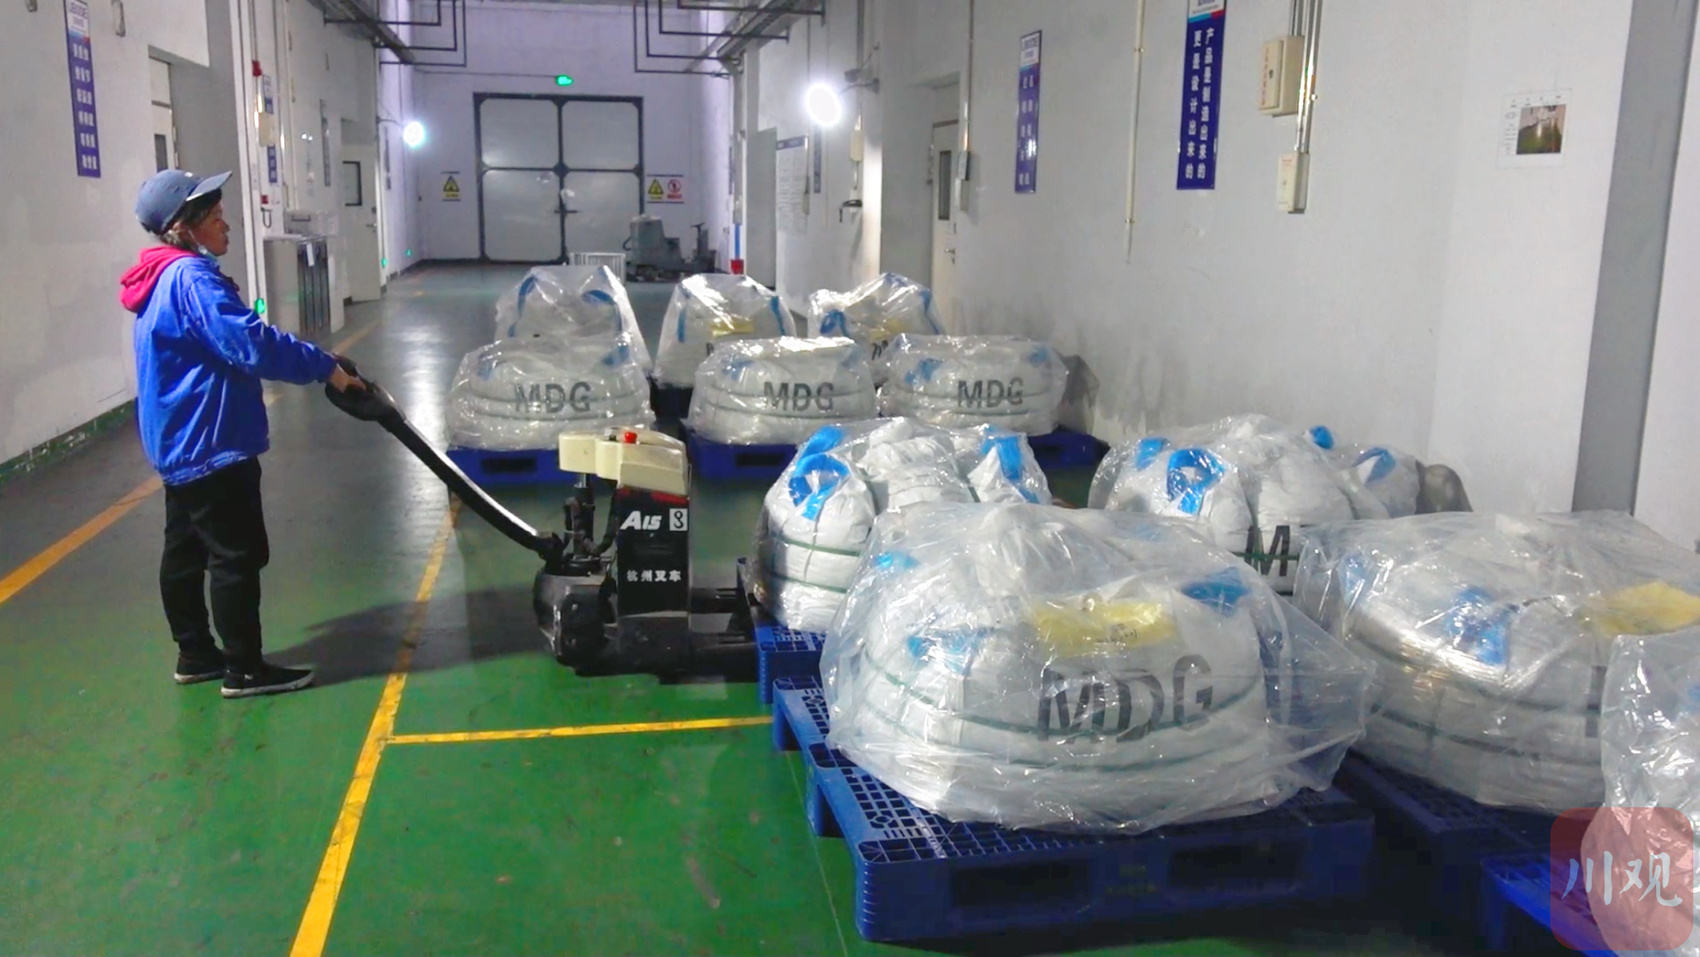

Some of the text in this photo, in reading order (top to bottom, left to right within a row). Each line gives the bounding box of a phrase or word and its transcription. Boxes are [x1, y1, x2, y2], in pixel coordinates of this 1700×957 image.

[514, 381, 591, 413] MDG
[763, 381, 835, 412] MDG
[957, 377, 1024, 409] MDG
[626, 569, 682, 583] 杭州叉车
[1037, 654, 1214, 744] MDG
